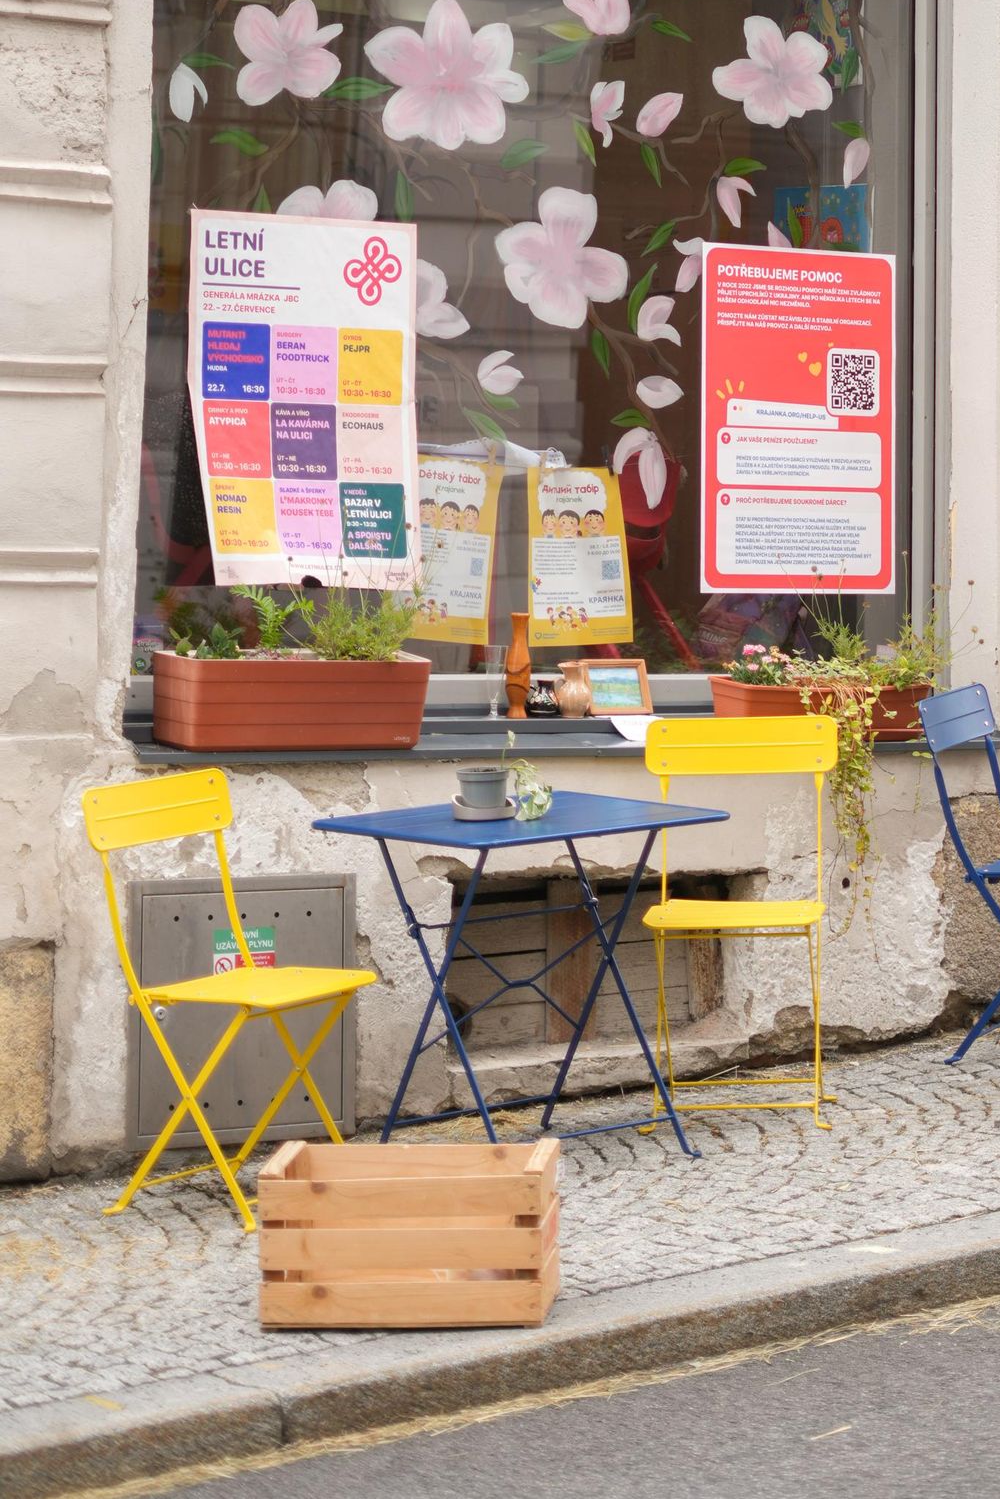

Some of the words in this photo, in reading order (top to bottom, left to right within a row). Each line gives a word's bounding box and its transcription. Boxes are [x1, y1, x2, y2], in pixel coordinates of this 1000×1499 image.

[205, 228, 265, 251] LETNÍ
[205, 257, 265, 278] ULICE
[717, 263, 799, 281] POTŘEBUJEME
[800, 269, 843, 284] POMOC
[203, 290, 246, 300] GENERÁLA
[246, 292, 280, 302] MRÁZKA
[284, 295, 300, 303] JBC
[203, 303, 215, 311] 22.
[223, 304, 233, 312] 27.
[234, 303, 277, 314] ČERVENCE
[208, 329, 246, 340] MUTANTI
[276, 341, 306, 350] BERAN
[343, 344, 370, 353] PEJPR
[276, 353, 330, 363] FOODTRUCK
[207, 364, 228, 372] HUDBA
[207, 383, 226, 392] 22.7.
[242, 384, 265, 394] 16:30
[276, 386, 298, 395] 10:30
[305, 387, 326, 396] 16:30
[343, 388, 364, 397] 10:30
[370, 390, 392, 398] 16:30
[275, 408, 290, 416] KÁVA
[209, 416, 247, 427] ATYPICA
[275, 419, 288, 428] LA
[289, 419, 330, 429] KAVÁRNA
[342, 421, 384, 431] ECOHAUS
[276, 431, 289, 440] NA
[290, 432, 313, 441] ULICI
[212, 461, 234, 470] 10:30
[240, 463, 261, 472] 16:30
[277, 464, 299, 473] 10:30
[305, 465, 327, 474] 16:30
[343, 466, 364, 475] 10:30
[371, 467, 392, 475] 16:30
[419, 469, 456, 483] Dětský
[459, 472, 481, 484] tábor
[216, 494, 247, 503] NOMAD
[344, 498, 372, 508] BAZAR
[373, 499, 381, 508] V
[736, 496, 752, 504] PROČ
[217, 505, 242, 514] RESIN
[281, 508, 313, 517] KOUSEK
[315, 509, 334, 518] TEBE
[346, 508, 369, 518] LETNÍ
[369, 510, 392, 519] ULICI
[348, 531, 355, 540] A
[355, 531, 392, 541] SPOUSTU
[284, 541, 306, 550] 10:30
[311, 542, 332, 550] 16:30
[450, 589, 482, 599] KRAJANKA
[588, 595, 624, 604] КРАЯНКА
[231, 929, 259, 939] HAVNÍ
[248, 940, 274, 949] PLYNU
